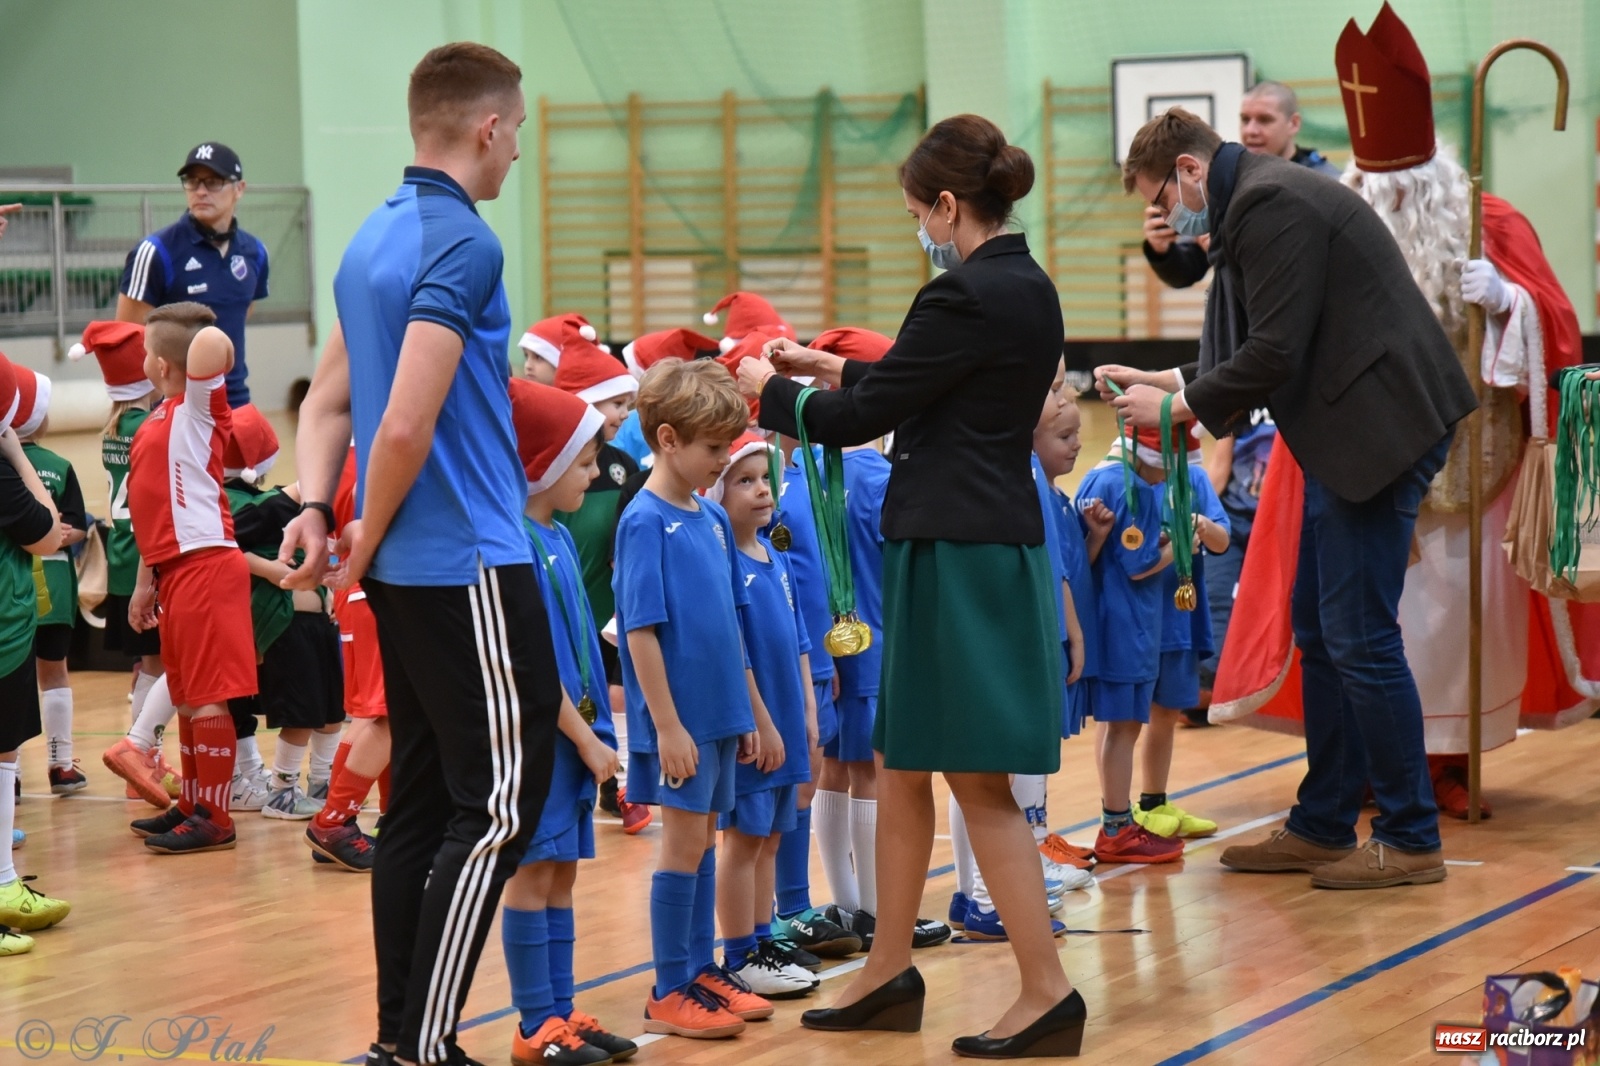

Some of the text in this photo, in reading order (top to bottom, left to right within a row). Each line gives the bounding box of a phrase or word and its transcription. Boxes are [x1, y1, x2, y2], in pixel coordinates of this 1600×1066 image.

[195, 145, 213, 160] NY
[194, 744, 231, 757] eza
[791, 919, 813, 937] FILA
